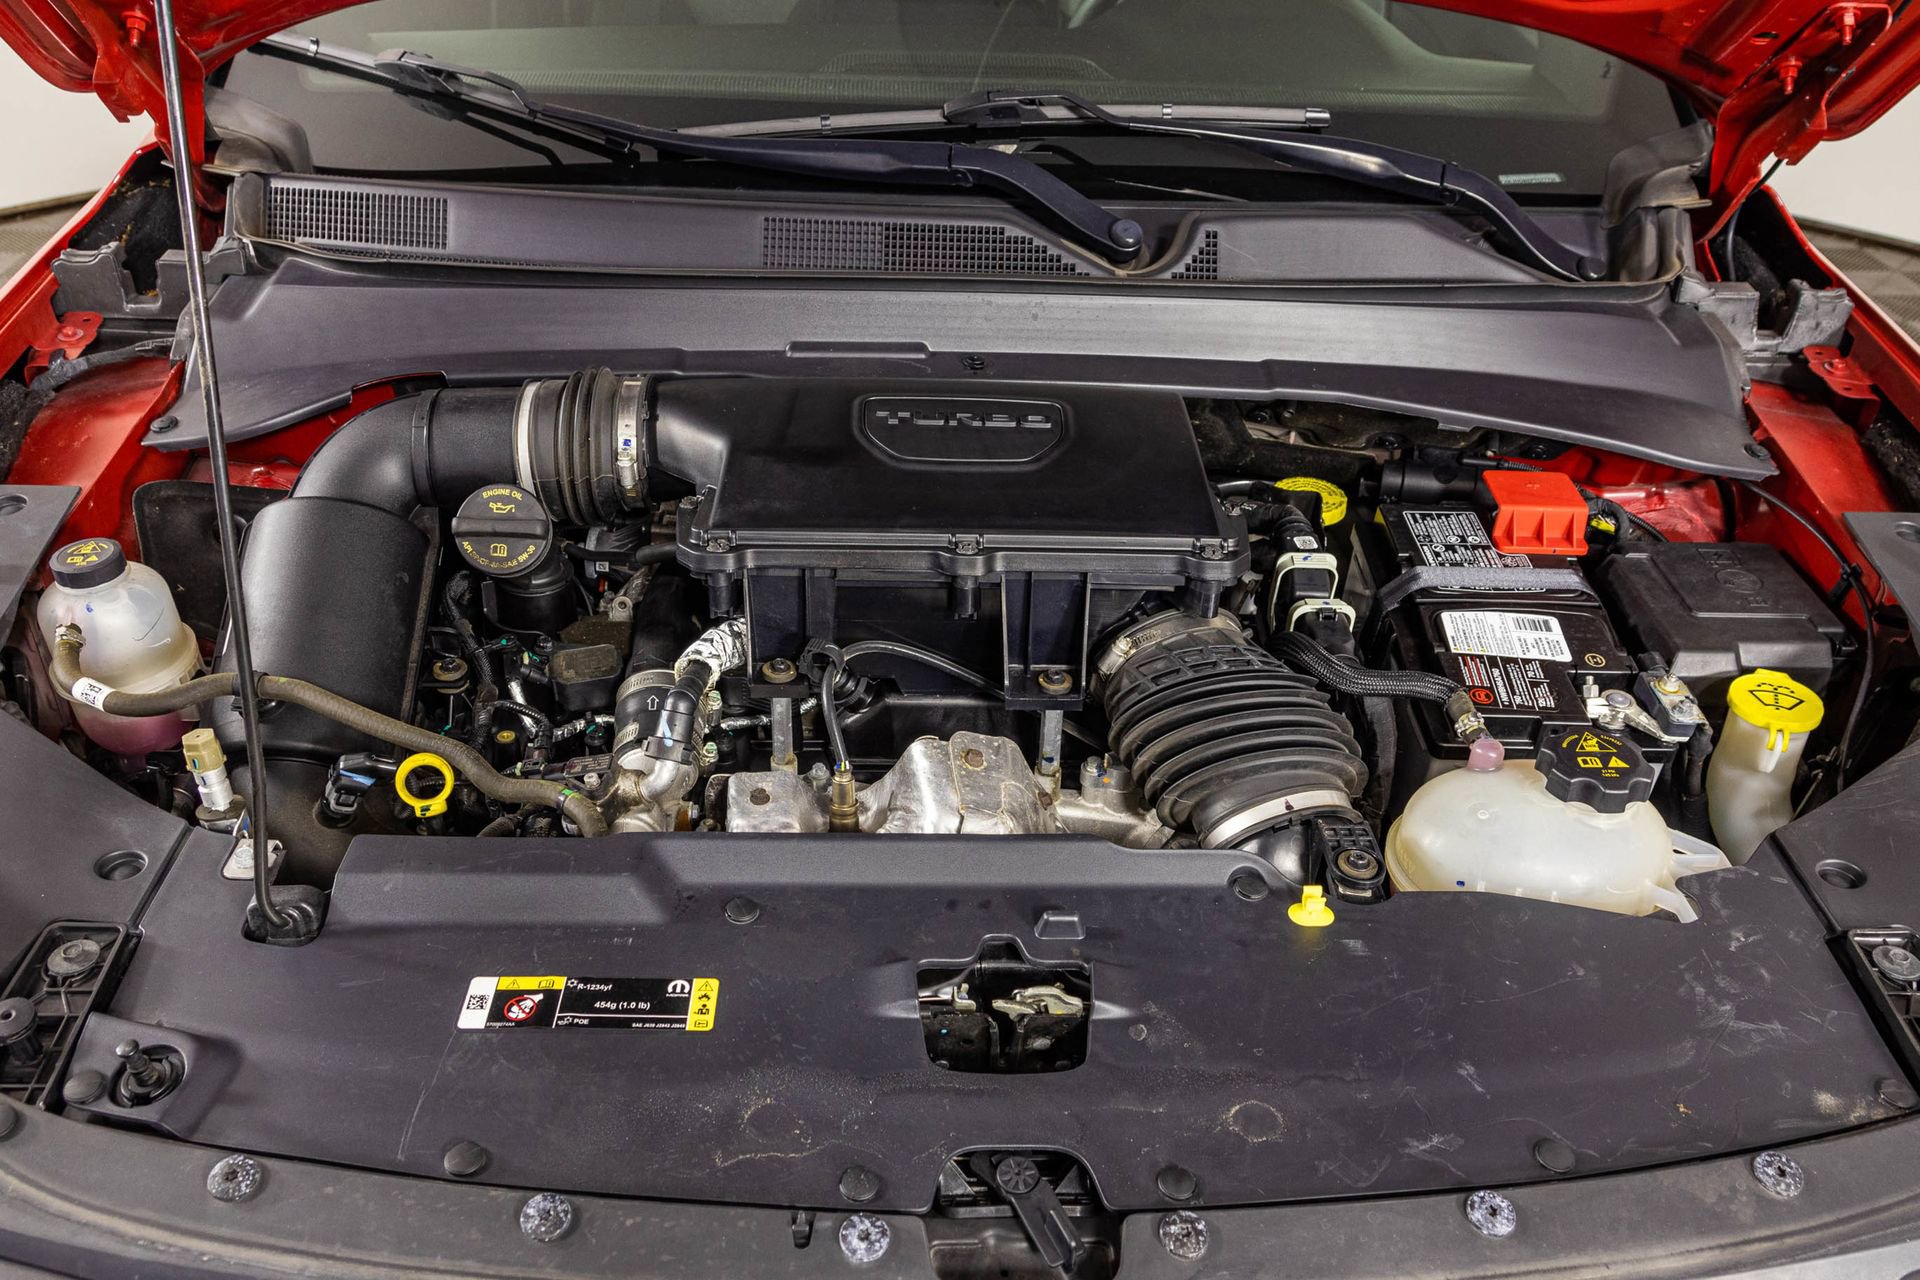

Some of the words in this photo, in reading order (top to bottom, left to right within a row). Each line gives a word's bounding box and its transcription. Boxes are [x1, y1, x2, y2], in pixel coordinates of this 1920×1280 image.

[875, 410, 1052, 429] TURBO
[482, 488, 511, 499] ENGINE
[511, 491, 523, 501] OIL
[462, 541, 473, 553] API
[518, 544, 536, 563] 5W-30
[577, 983, 613, 992] R-1234yf
[594, 1001, 617, 1010] 454g
[619, 1001, 636, 1010] (1.0
[638, 1002, 651, 1011] lb)
